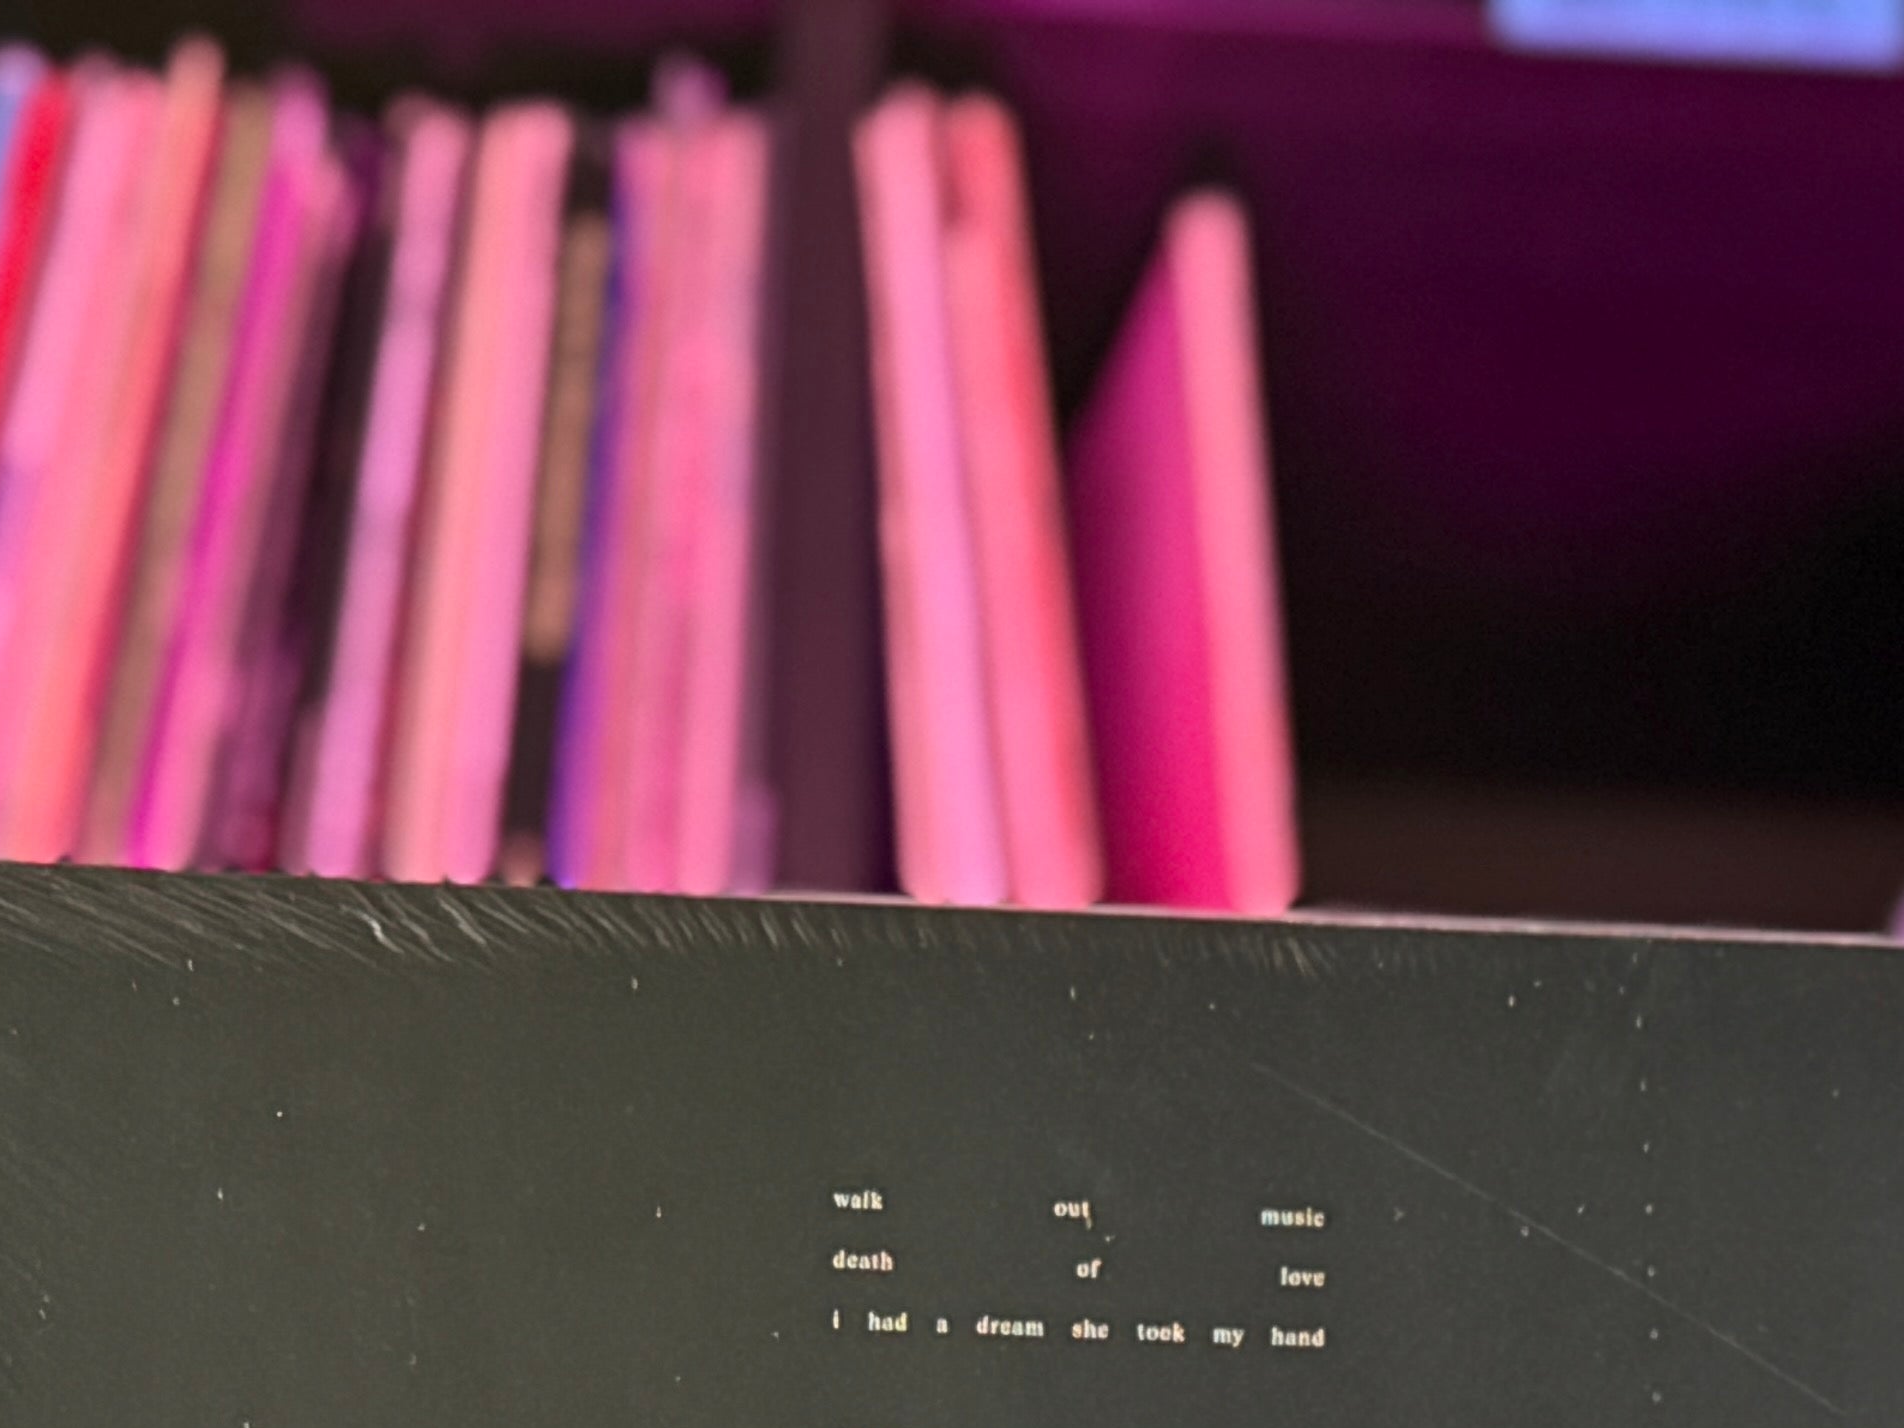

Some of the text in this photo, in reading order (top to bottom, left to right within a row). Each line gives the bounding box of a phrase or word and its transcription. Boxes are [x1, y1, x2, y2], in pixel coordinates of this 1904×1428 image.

[833, 1190, 1325, 1228] walk out music
[832, 1249, 1326, 1288] death of love
[868, 1311, 908, 1332] had
[936, 1317, 949, 1334] a
[975, 1315, 1044, 1337] dream
[1071, 1318, 1109, 1340] she
[1136, 1321, 1186, 1343] took
[1212, 1327, 1245, 1348] my
[1271, 1326, 1325, 1348] hand
